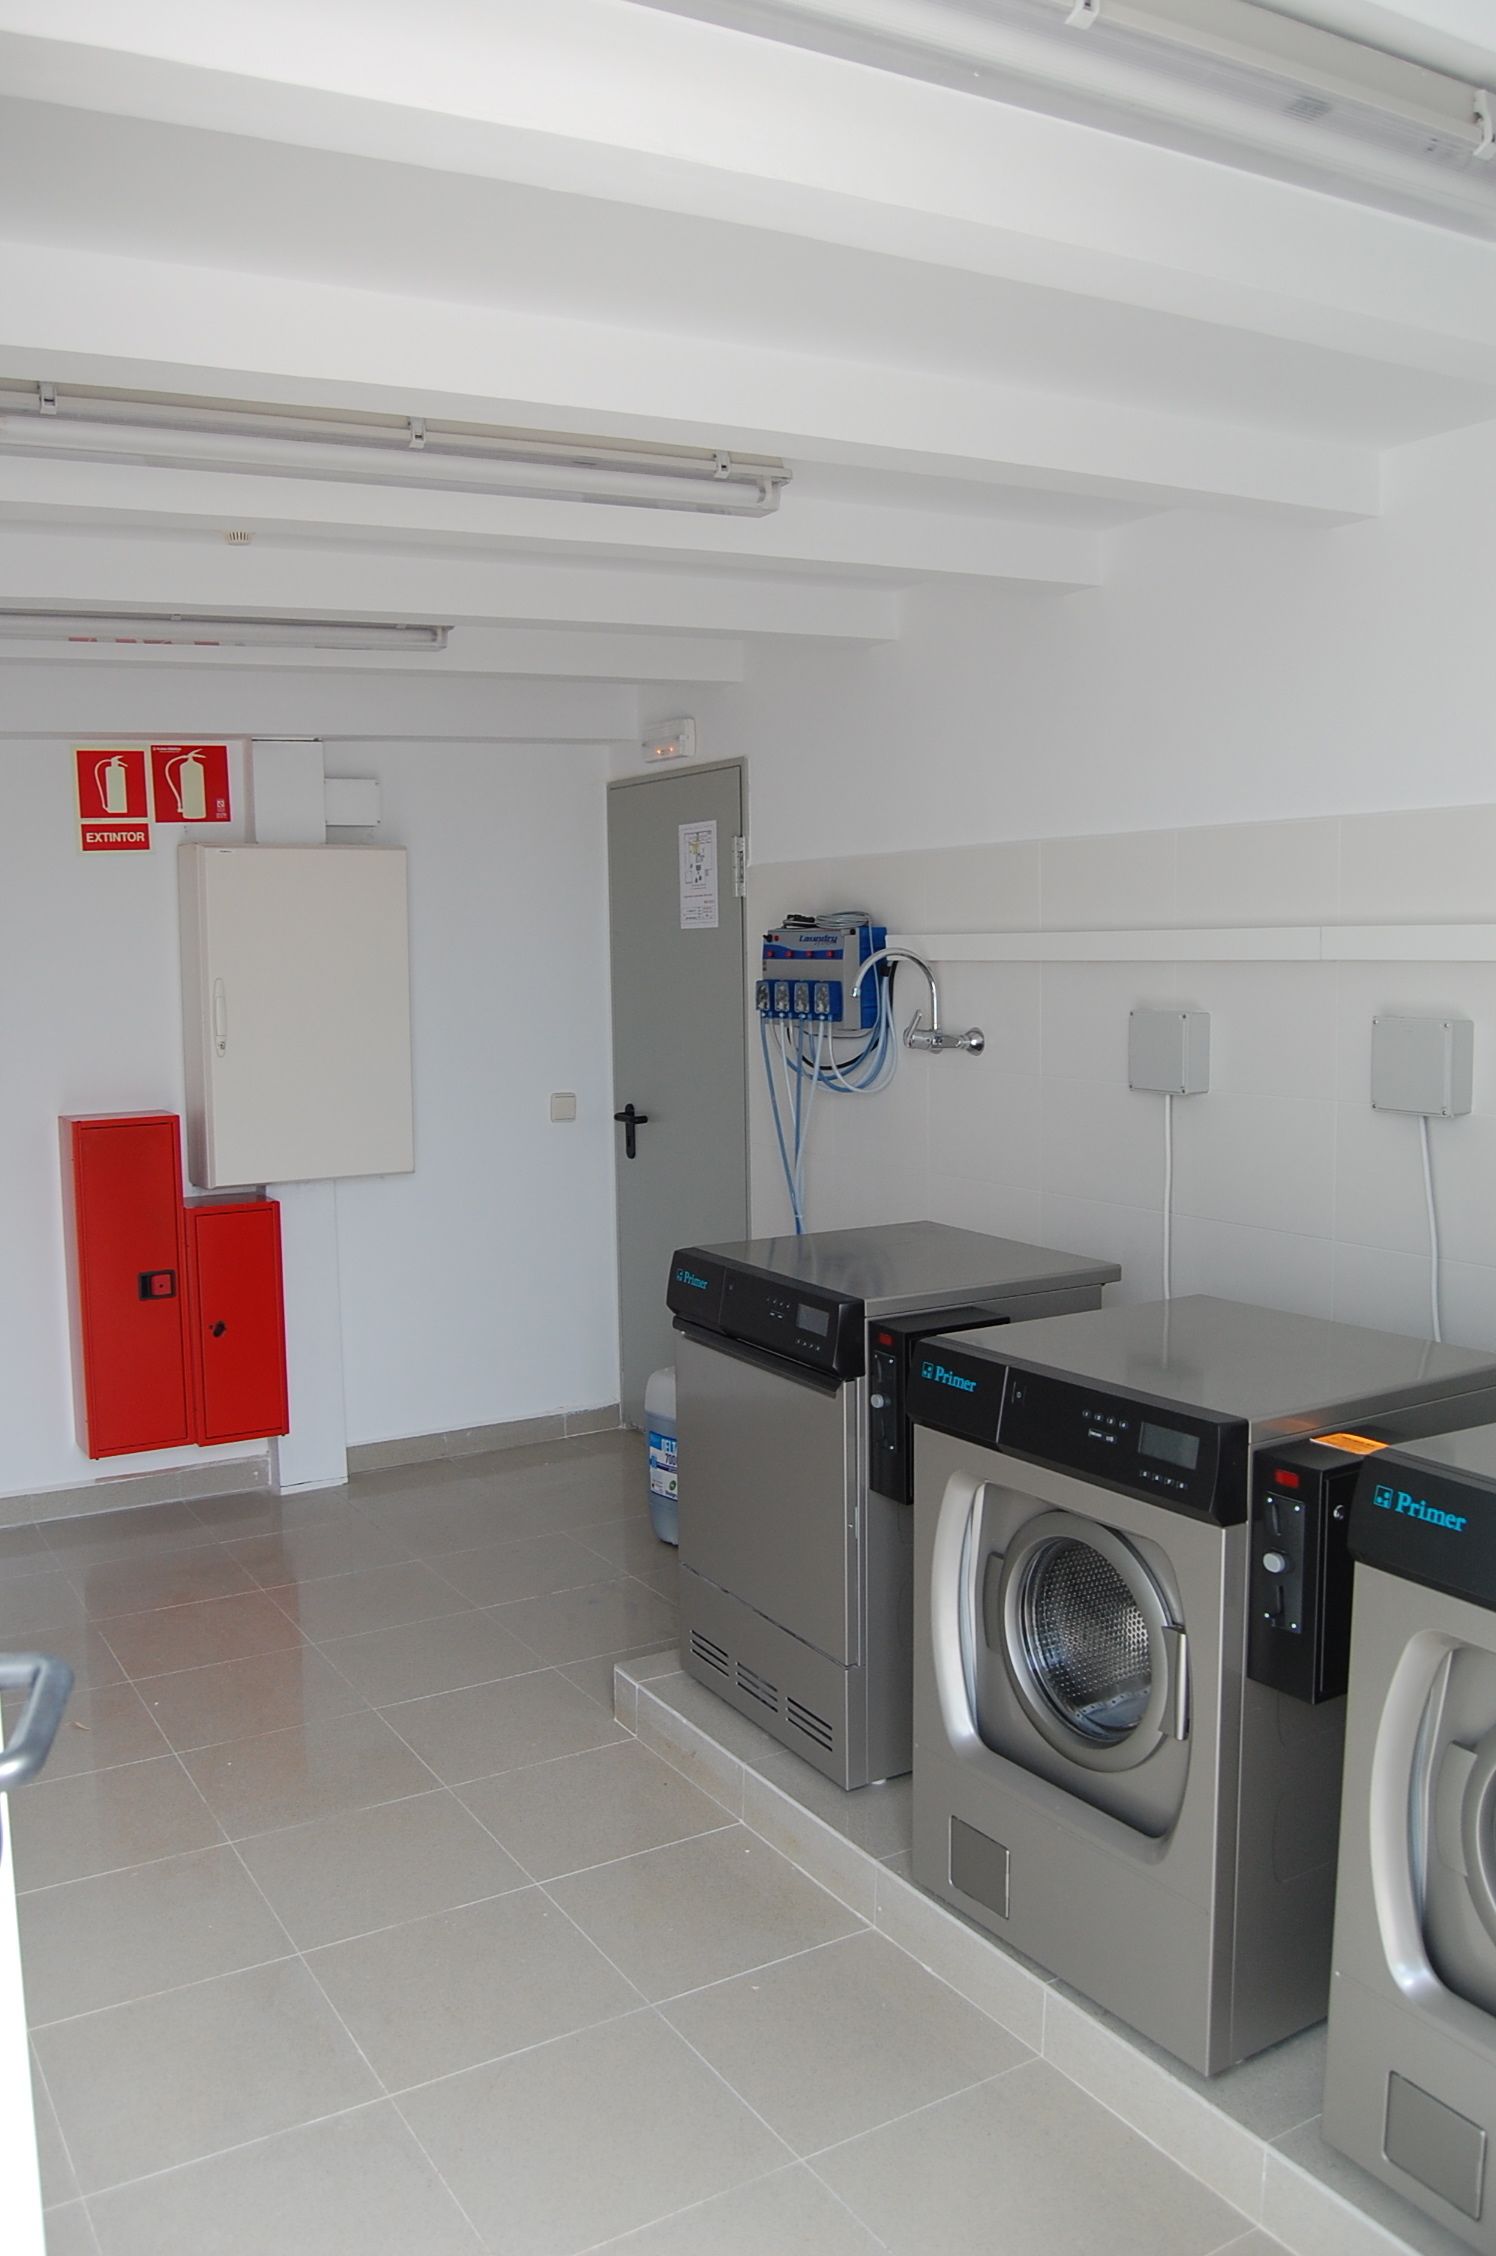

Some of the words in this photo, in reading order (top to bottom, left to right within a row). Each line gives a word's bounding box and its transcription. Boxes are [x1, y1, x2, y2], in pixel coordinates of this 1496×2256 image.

[86, 831, 145, 843] EXTINTOR
[684, 1271, 708, 1289] Primer
[935, 1365, 977, 1392] Primer
[1395, 1491, 1467, 1532] Primer
